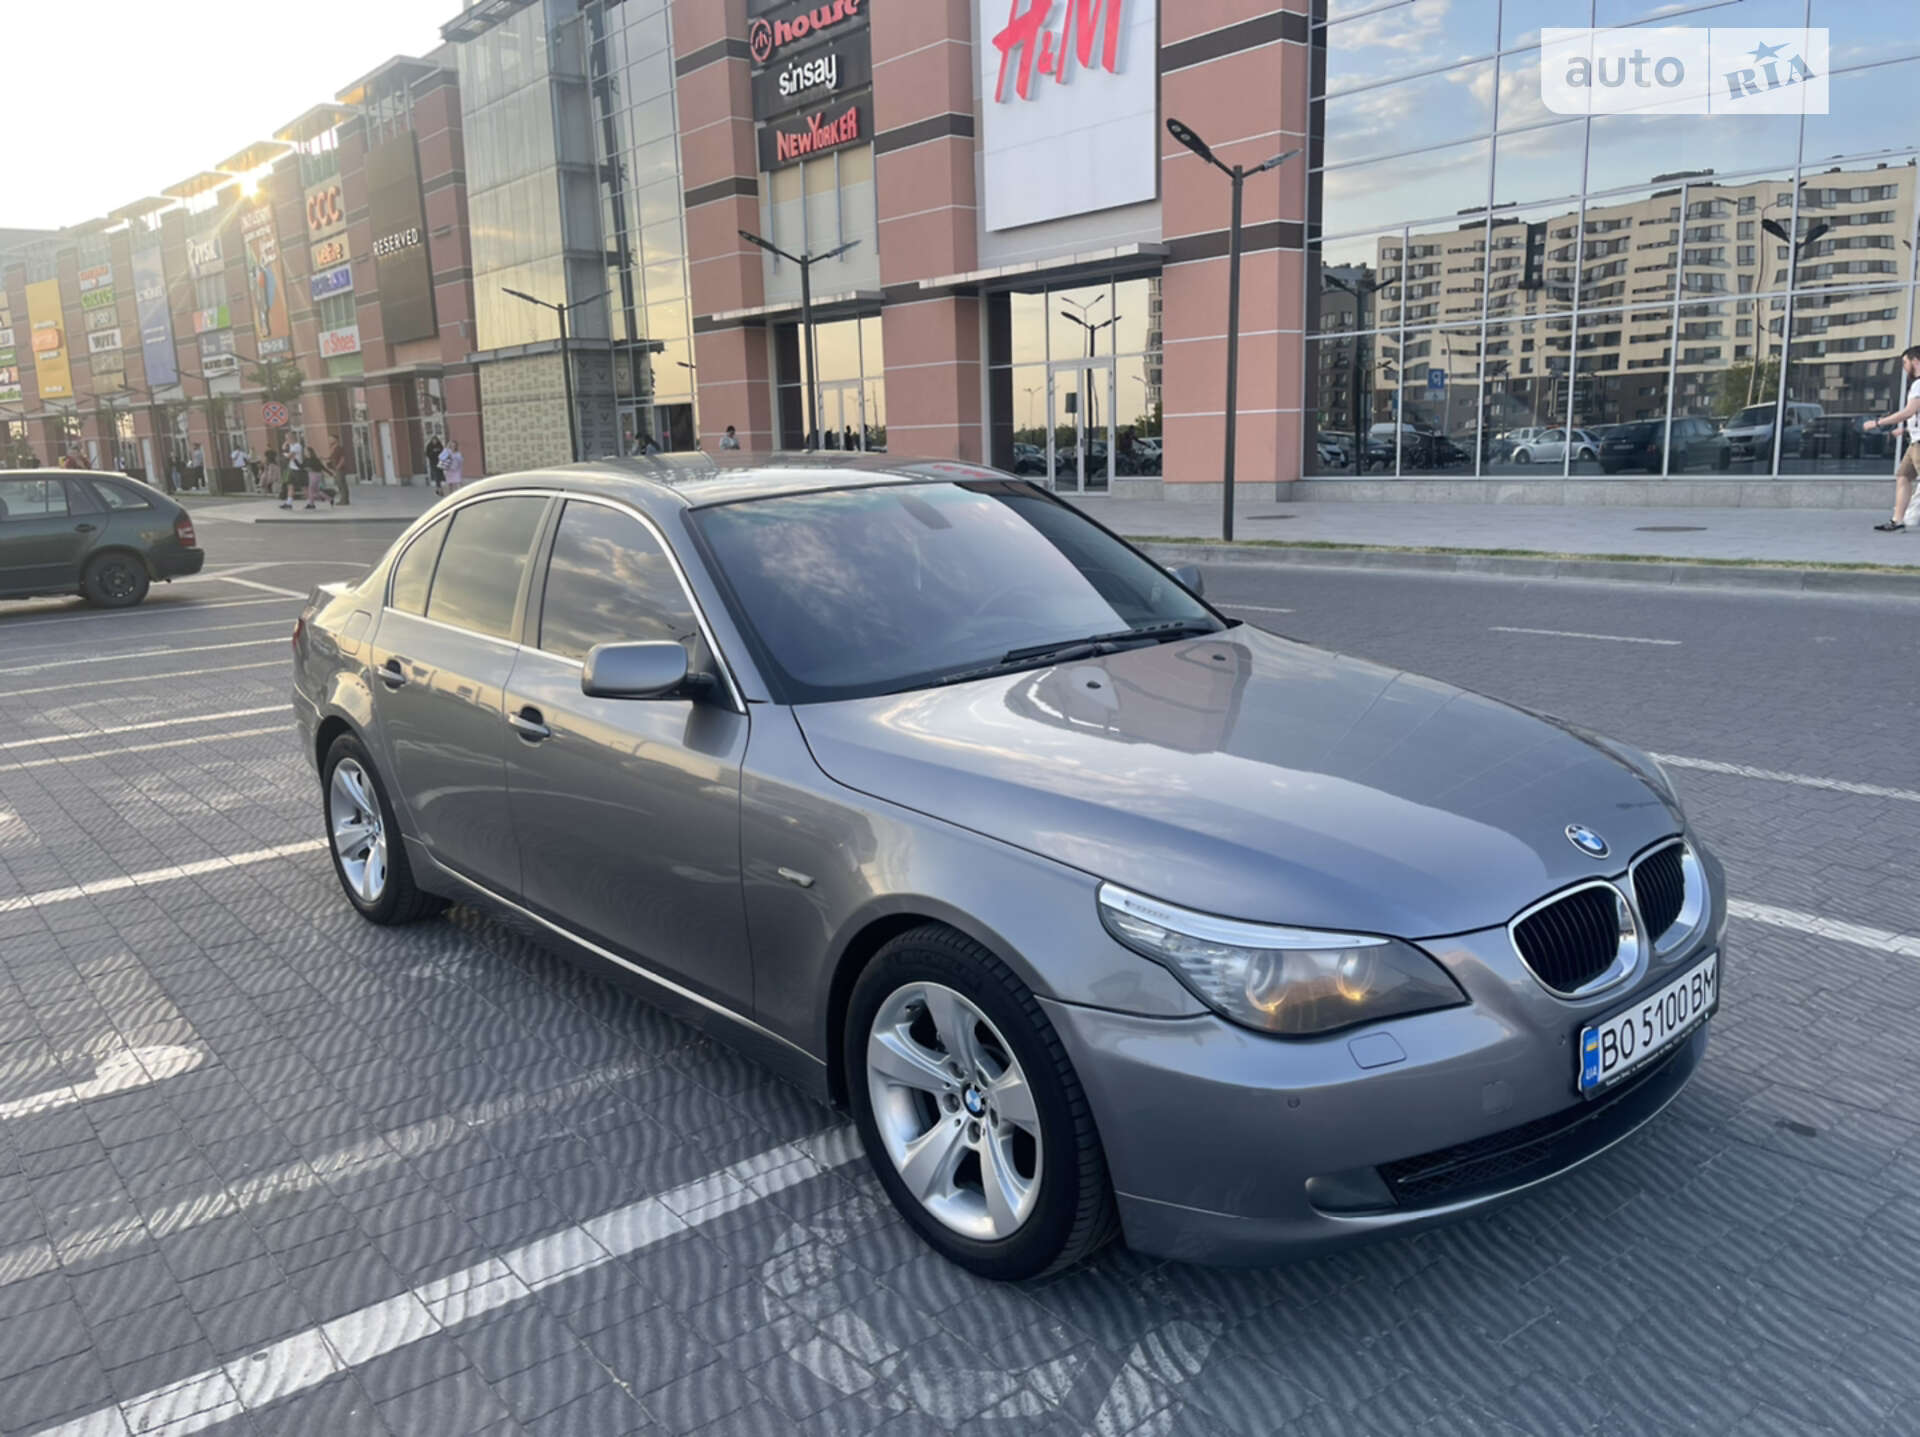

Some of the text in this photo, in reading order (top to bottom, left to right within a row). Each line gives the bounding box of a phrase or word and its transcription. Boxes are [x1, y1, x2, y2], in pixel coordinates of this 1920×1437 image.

[992, 0, 1121, 102] H&M
[779, 54, 838, 97] sinsay
[307, 186, 343, 230] CCC
[372, 227, 418, 257] RESERVED
[1642, 984, 1688, 1047] 5100
[1692, 964, 1717, 1014] BM
